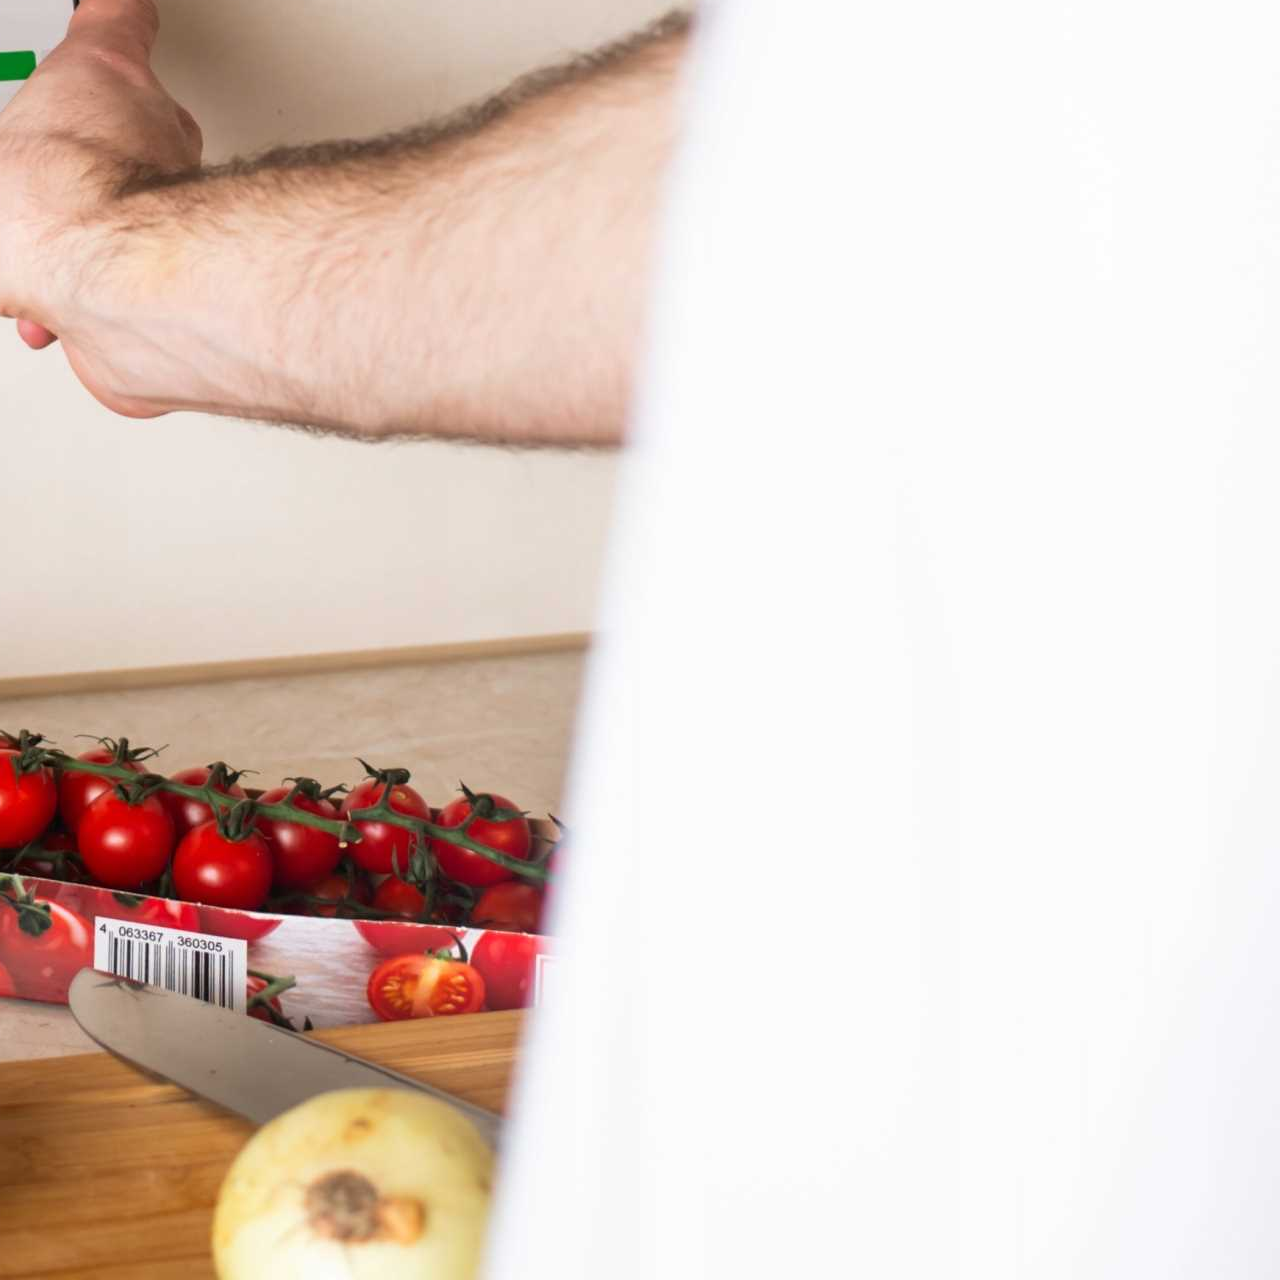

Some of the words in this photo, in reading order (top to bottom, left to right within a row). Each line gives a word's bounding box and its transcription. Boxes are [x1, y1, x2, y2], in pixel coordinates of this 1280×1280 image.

[99, 923, 107, 933] 4
[118, 926, 163, 943] 063367
[177, 936, 223, 953] 360305
